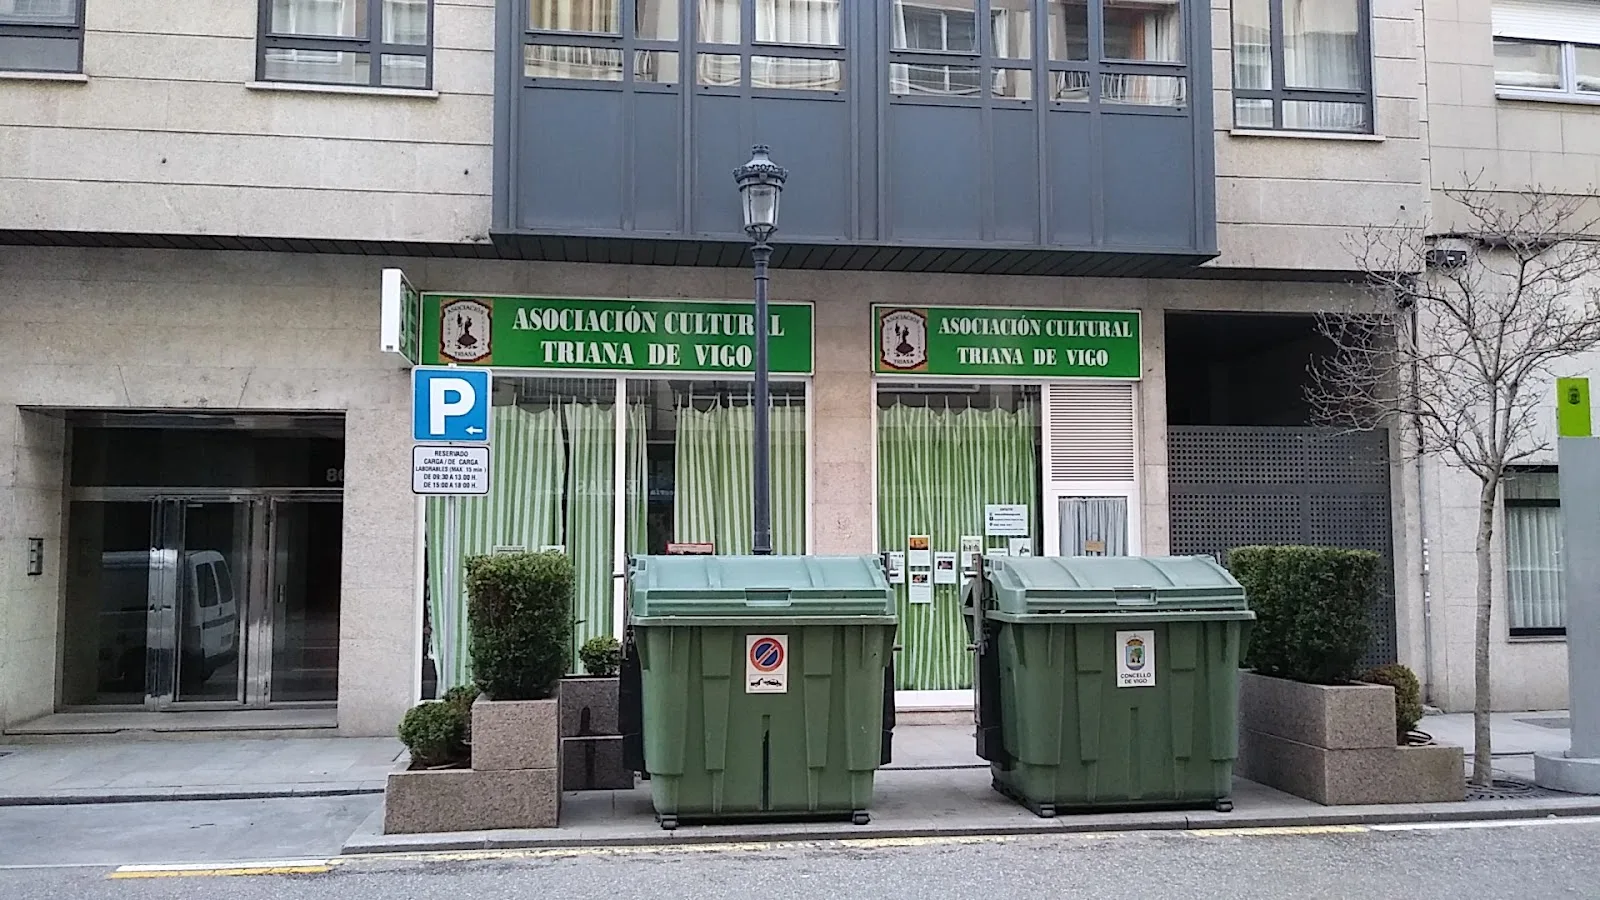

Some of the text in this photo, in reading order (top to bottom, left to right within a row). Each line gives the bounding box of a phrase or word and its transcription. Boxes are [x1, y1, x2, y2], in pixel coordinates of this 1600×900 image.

[512, 305, 785, 336] ASOCIACIÓN CULTURL
[938, 315, 1133, 338] ASOCIACIÓN CULTURAL
[541, 340, 752, 368] TRIANA DE VIGO
[957, 346, 1109, 367] TRIANA DE VIGO
[429, 377, 476, 435] P
